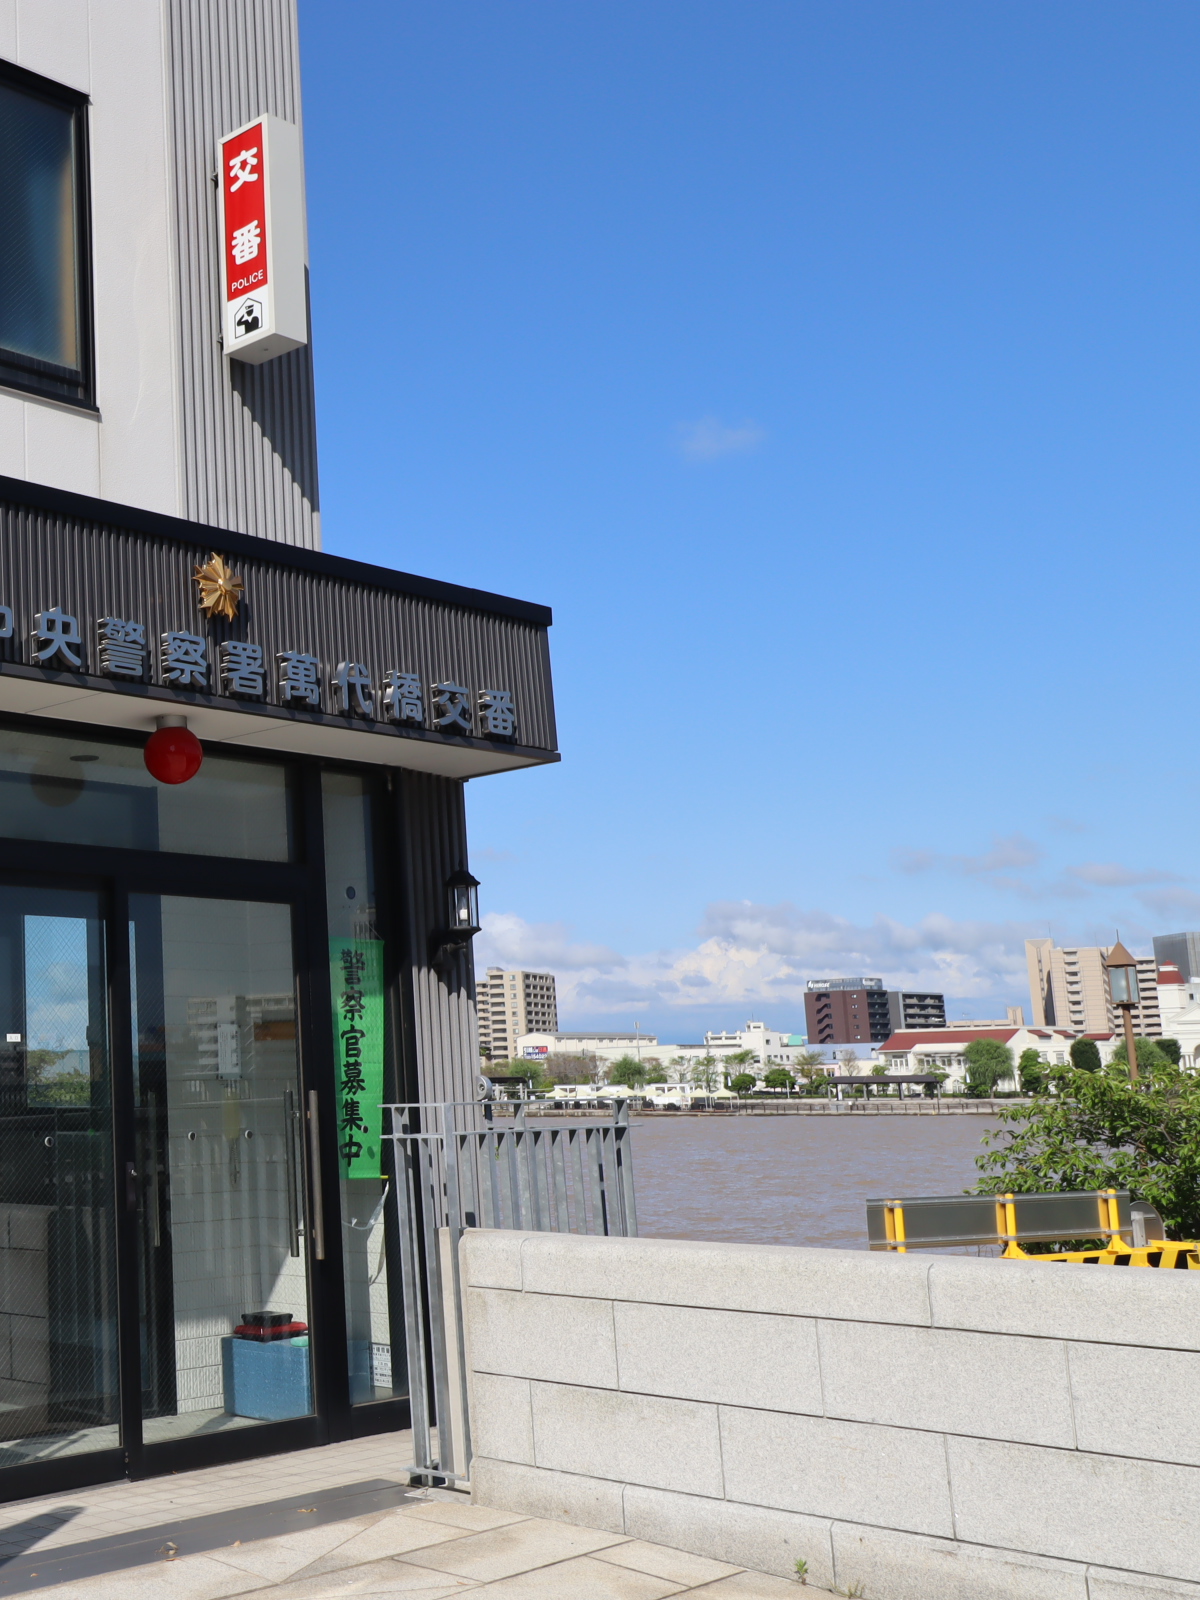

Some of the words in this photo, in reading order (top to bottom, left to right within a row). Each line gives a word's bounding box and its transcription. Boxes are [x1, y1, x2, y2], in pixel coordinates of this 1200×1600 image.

[228, 146, 261, 265] 交番
[231, 269, 264, 292] POLICE
[339, 948, 366, 1167] 警察官募集中
